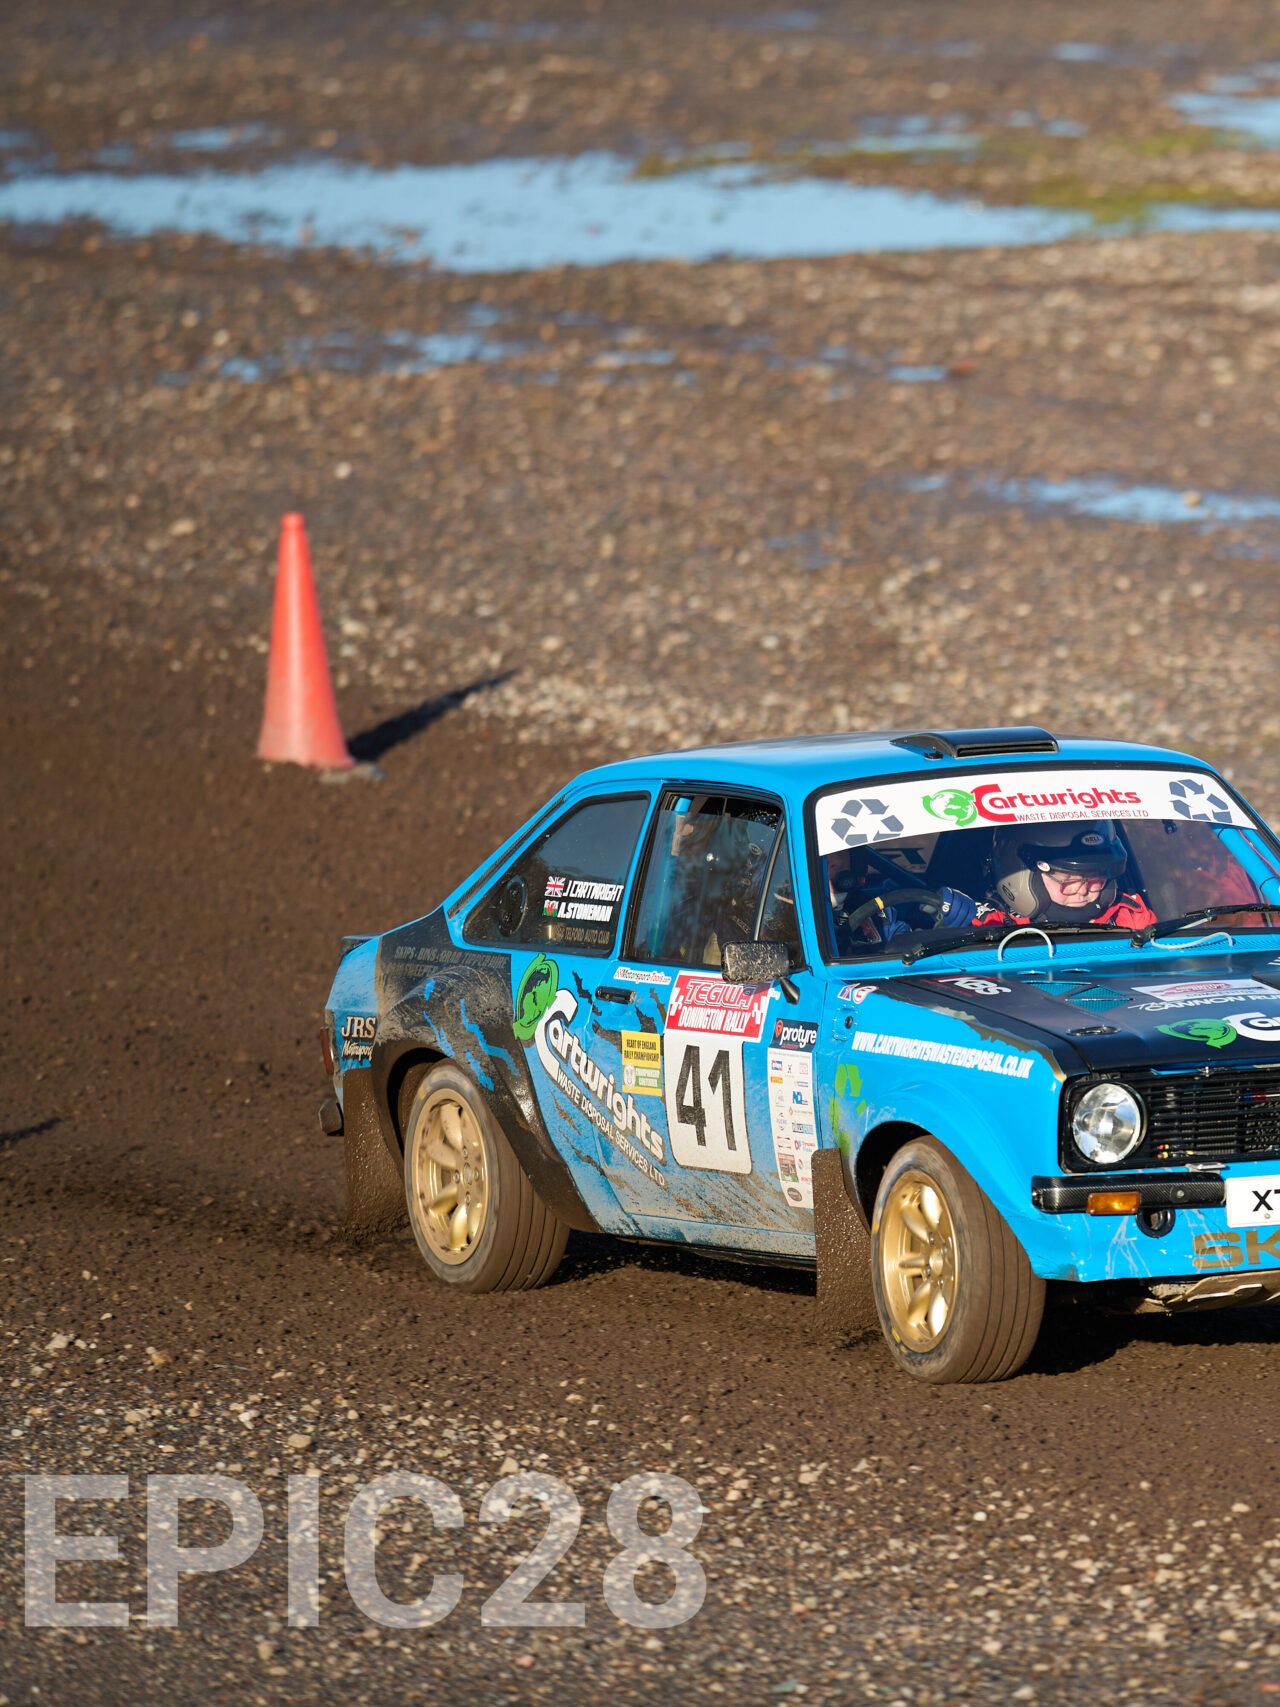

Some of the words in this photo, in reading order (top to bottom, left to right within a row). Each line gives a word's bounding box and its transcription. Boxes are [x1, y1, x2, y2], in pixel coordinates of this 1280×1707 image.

[973, 784, 1142, 823] Cartwrights
[1017, 813, 1047, 822] WASTE
[1050, 811, 1090, 820] DISPOSAL
[1092, 810, 1130, 819] SERVICES
[1133, 809, 1149, 818] LTD
[557, 902, 613, 922] A.STONEMAN
[685, 979, 758, 1010] TEGIWA
[1145, 994, 1246, 1012] CANNON
[341, 1016, 377, 1039] JRS
[678, 1006, 727, 1031] DONINGTON
[722, 1010, 752, 1033] RALLY
[779, 1025, 817, 1049] protyre
[634, 1051, 660, 1062] CHAMPIONSHIP
[535, 989, 665, 1162] Cartwrights
[675, 1044, 737, 1151] 41
[557, 1071, 581, 1106] WASTE
[581, 1096, 615, 1140] DISPOSAL
[615, 1132, 649, 1175] SERVICES
[649, 1164, 665, 1187] LTD
